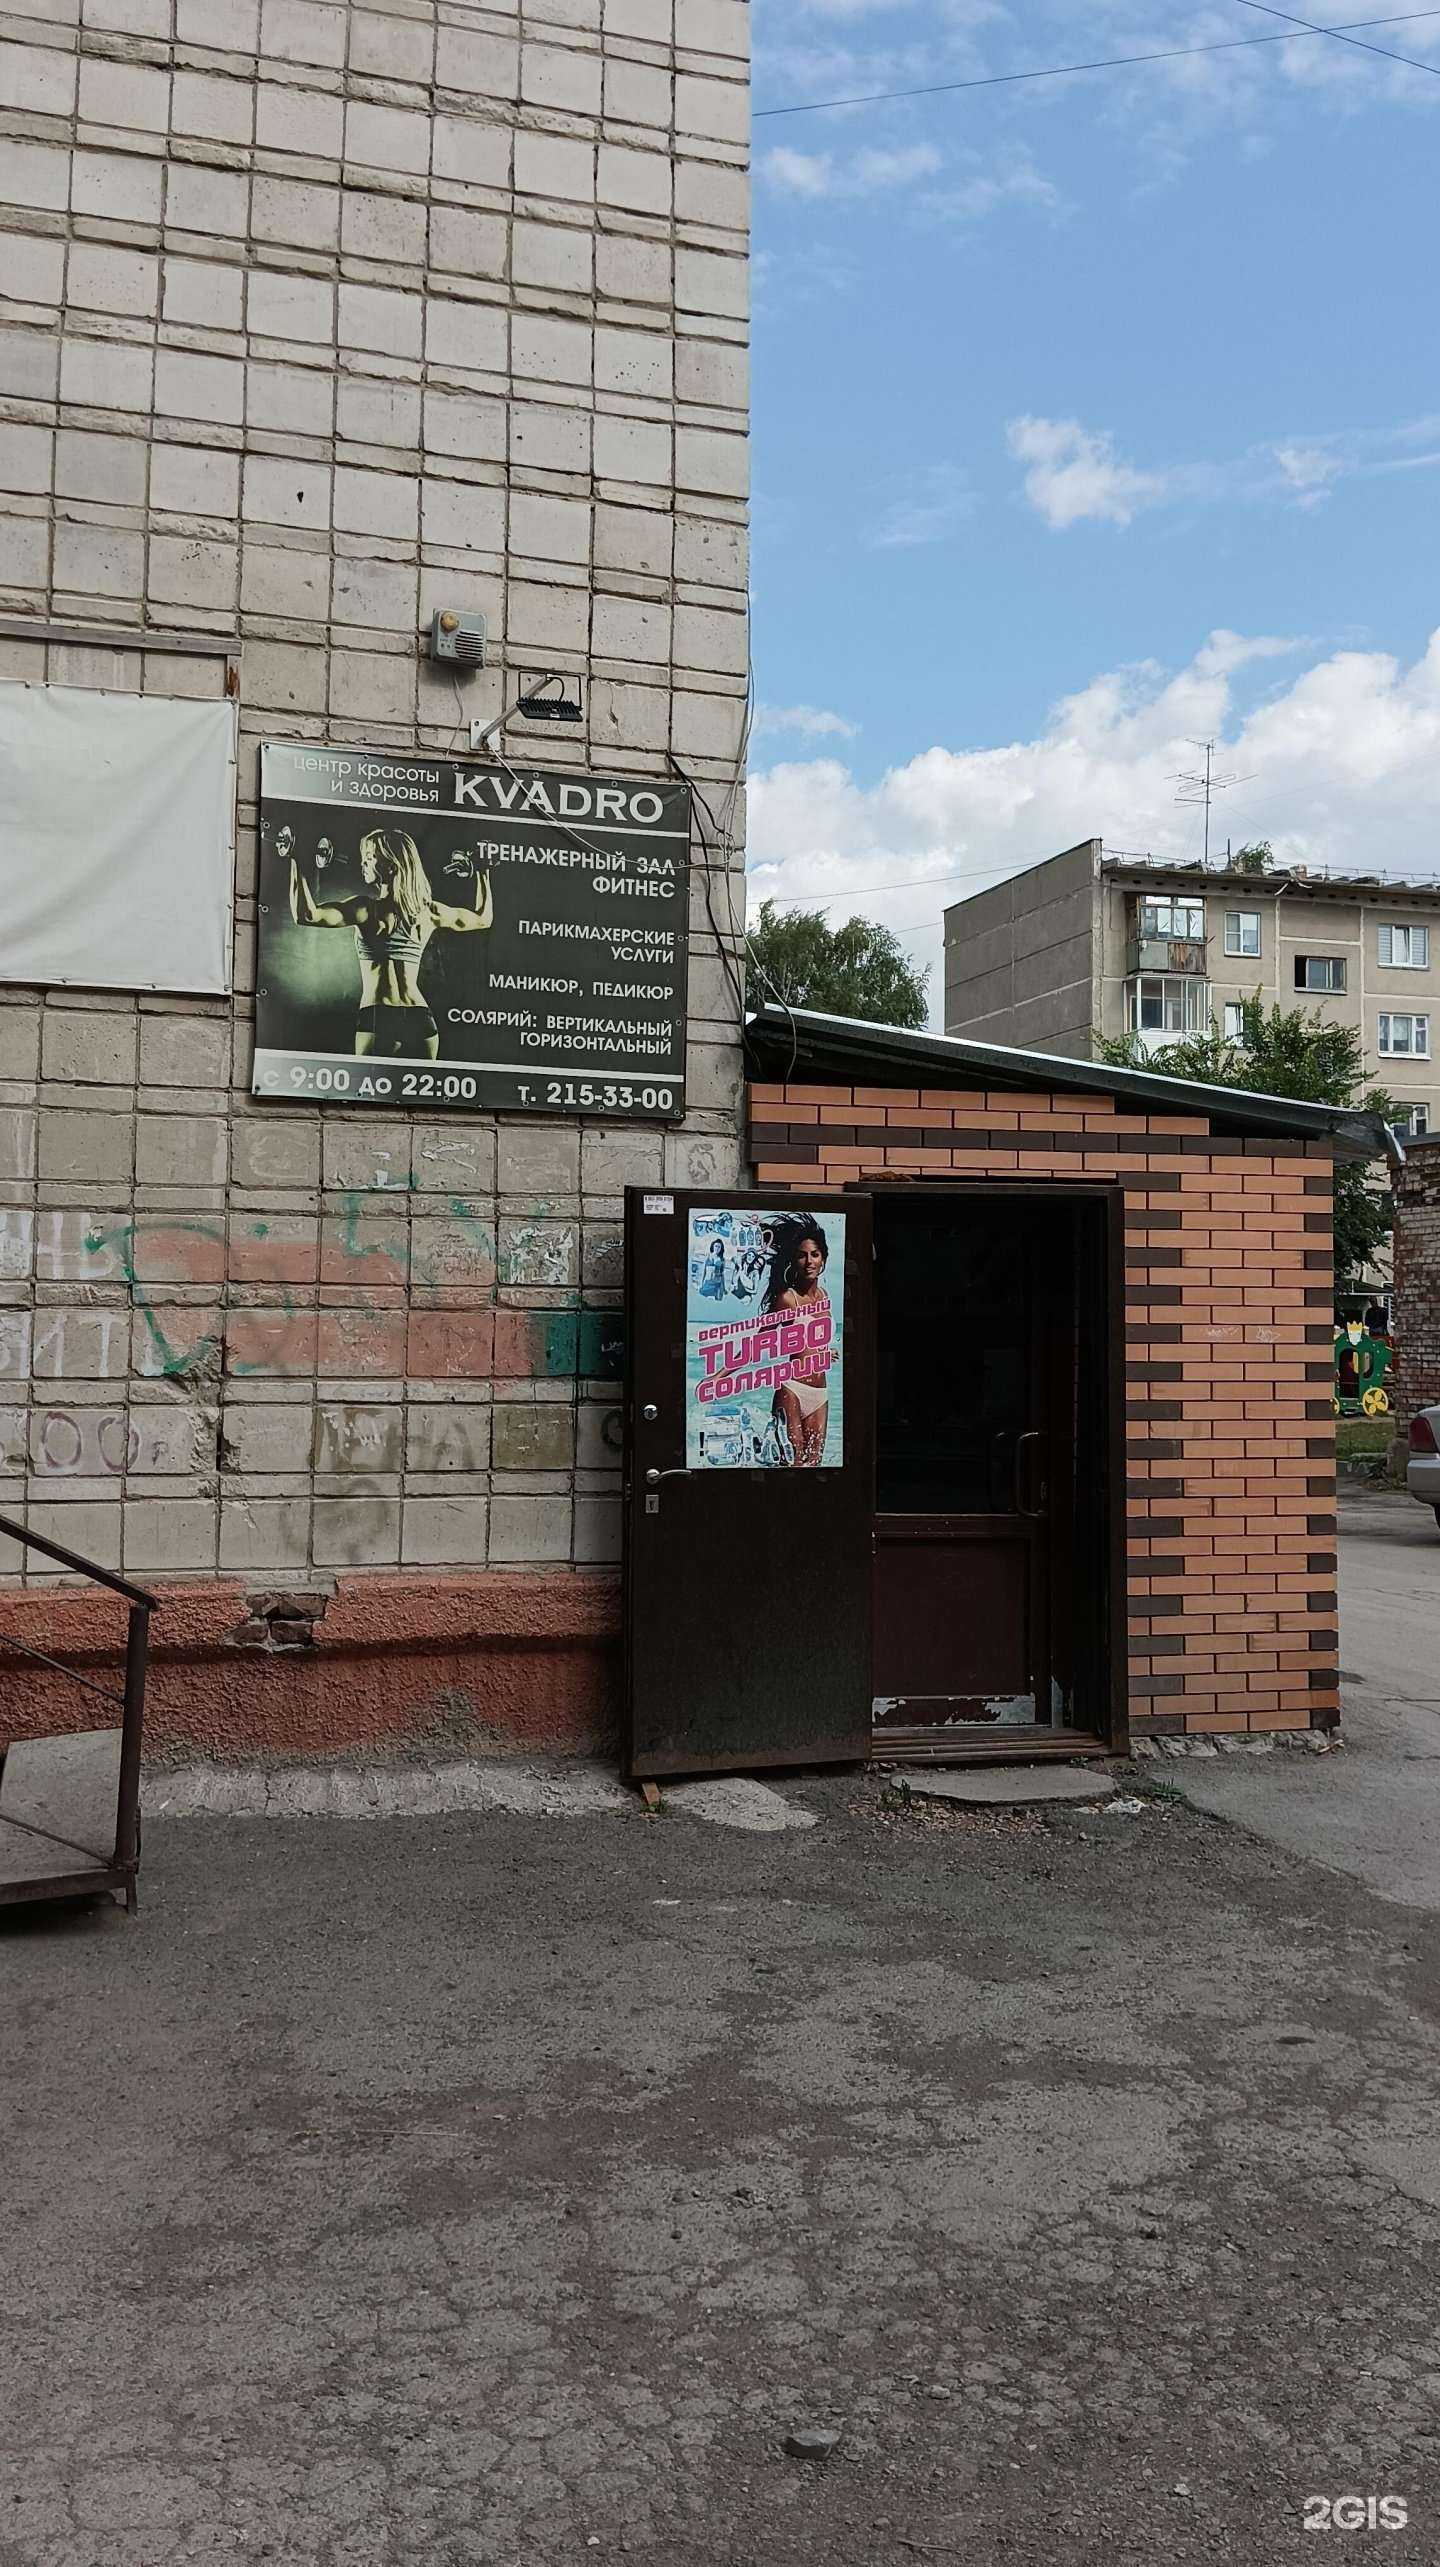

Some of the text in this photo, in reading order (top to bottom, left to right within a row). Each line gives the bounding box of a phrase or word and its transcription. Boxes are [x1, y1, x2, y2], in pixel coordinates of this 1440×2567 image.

[295, 756, 440, 784] центр красоты
[331, 780, 440, 803] и здоровья
[454, 772, 664, 823] KVADRO
[477, 841, 676, 876] ТРЕНАЖЕРНЫЙ ЗАЛ
[592, 875, 676, 898] ФИТНЕС
[518, 919, 675, 946] ПАРИКМАХЕРСКИЕ
[611, 946, 674, 964] УСЛУГИ
[489, 974, 674, 1001] МАНИКЮР, ПЕДИКЮР
[447, 1007, 672, 1037] СОЛЯРИЙ: ВЕРТИКАЛЬНЫЙ
[520, 1031, 672, 1056] ГОРИЗОНТАЛЬНЫЙ
[290, 1065, 350, 1092] 9:00
[358, 1076, 392, 1096] до
[402, 1073, 477, 1099] 22:00
[518, 1084, 537, 1103] т.
[546, 1082, 674, 1111] 215-33-00
[698, 1297, 831, 1342] вертикальный
[698, 1316, 833, 1376] TURBO
